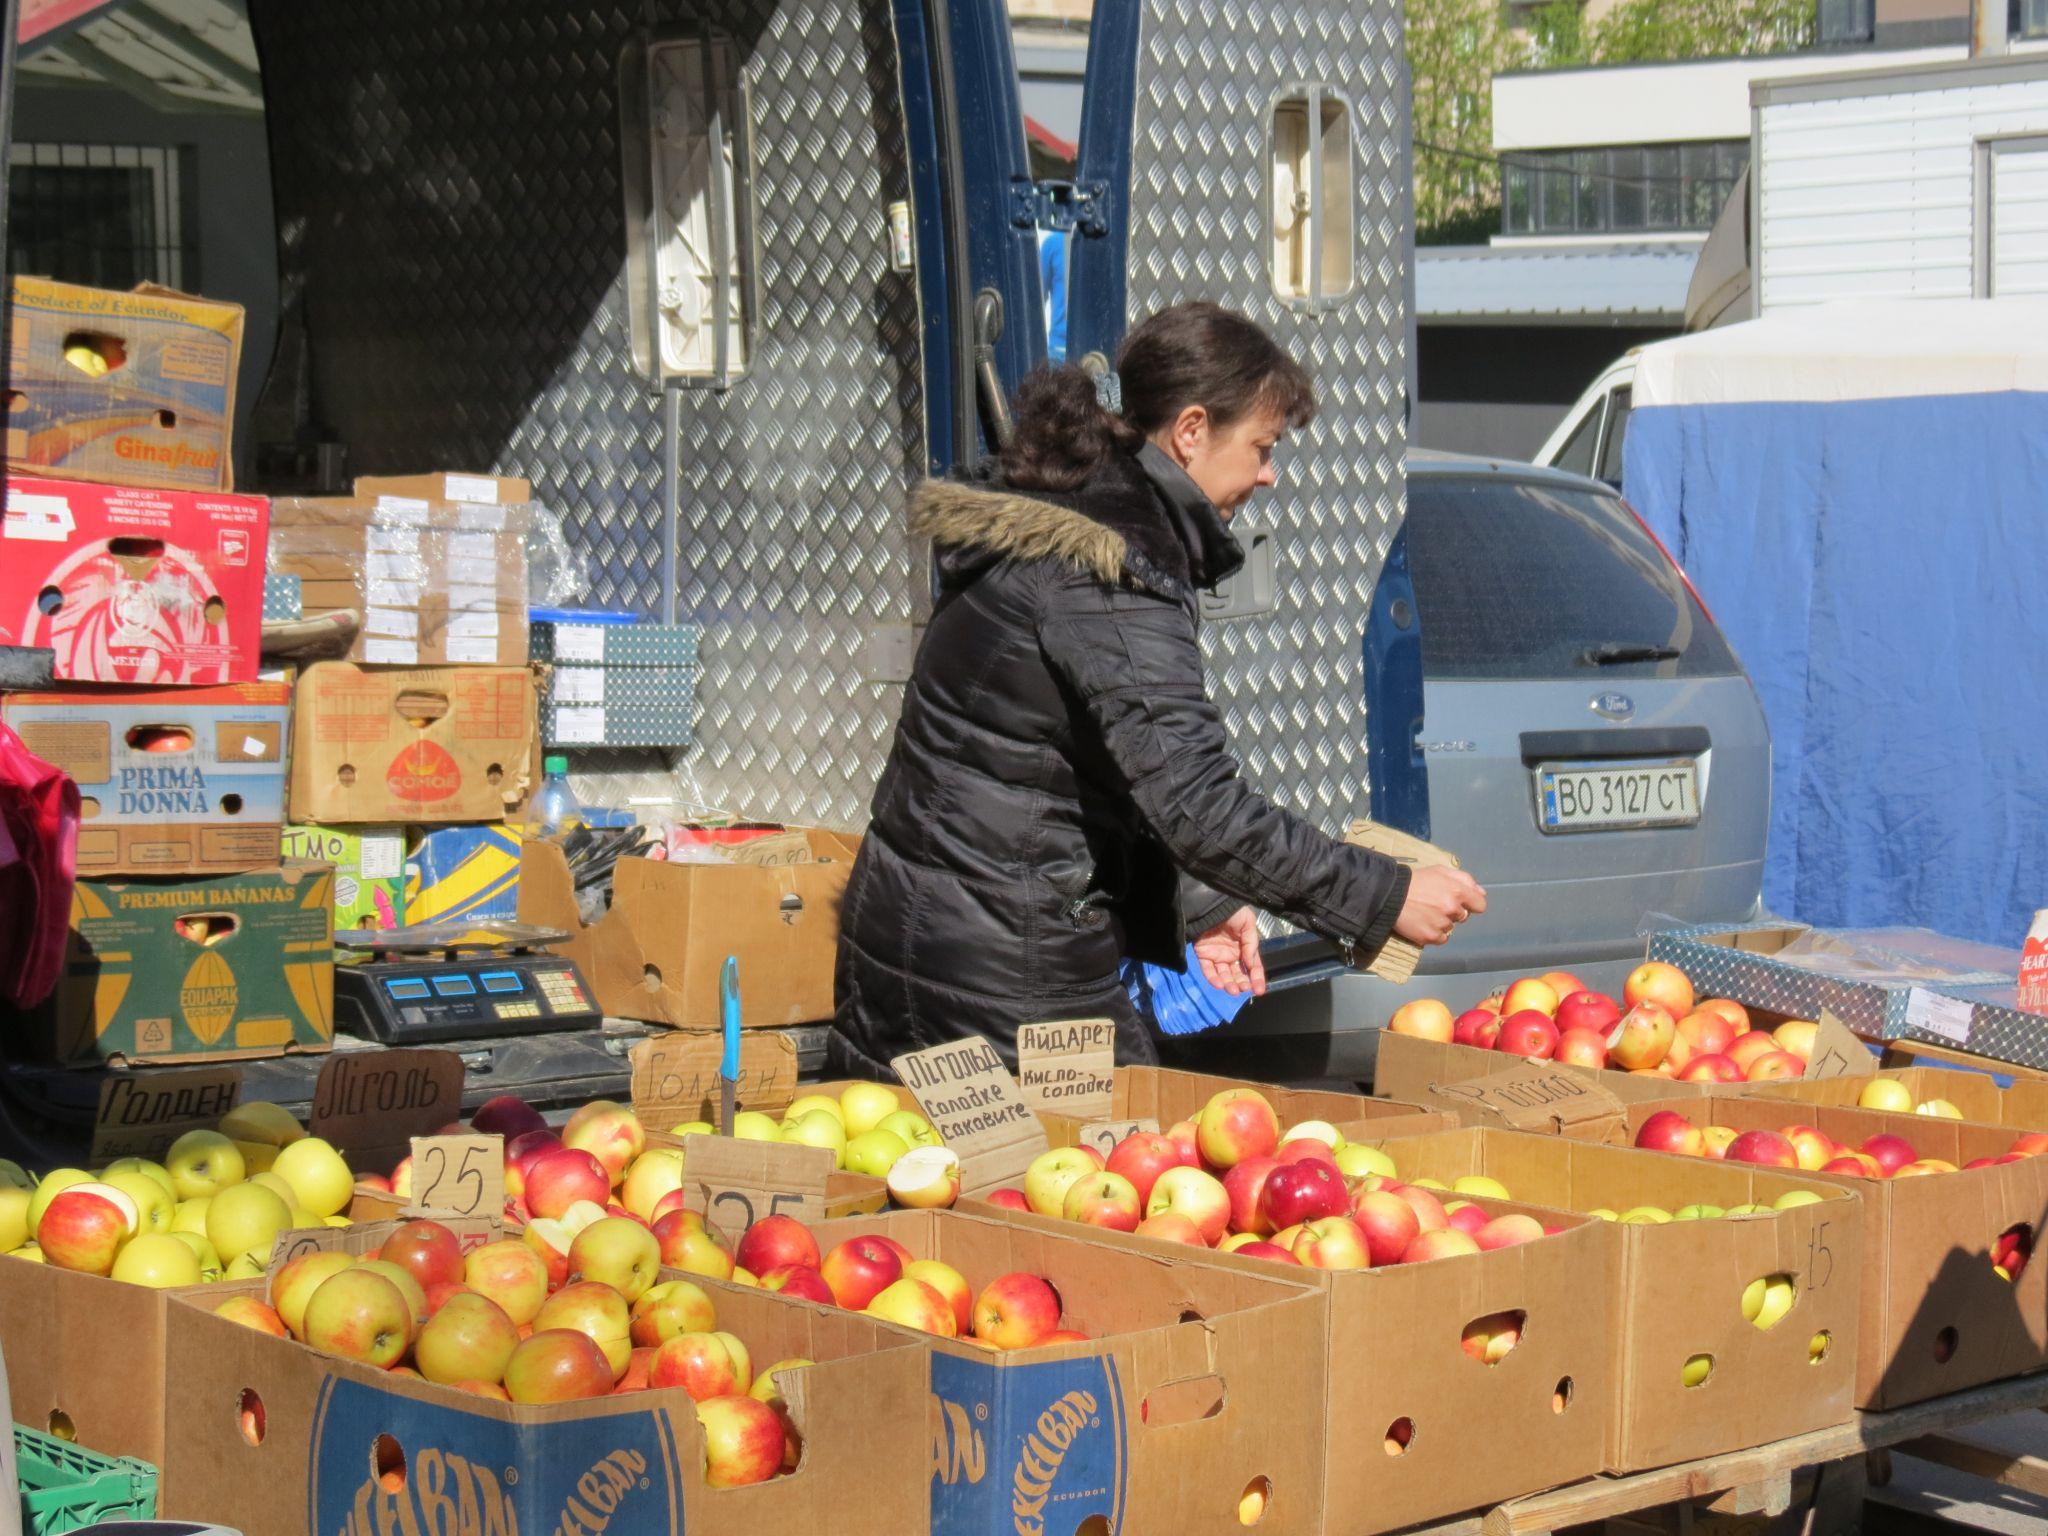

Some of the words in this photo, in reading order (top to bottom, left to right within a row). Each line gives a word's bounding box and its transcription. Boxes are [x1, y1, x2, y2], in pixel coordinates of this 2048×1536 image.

[89, 299, 106, 311] of
[112, 301, 188, 322] Ecuador
[114, 435, 219, 471] Ginafruit
[1605, 695, 1629, 711] Ford
[119, 766, 206, 789] PRIMA
[118, 791, 208, 814] DONNA
[1600, 774, 1651, 814] 3127
[1657, 772, 1688, 811] CT
[119, 890, 206, 909] PREMIUM
[209, 887, 296, 905] BANANAS
[180, 986, 239, 1007] EQUAPAK
[188, 1007, 231, 1018] ECUADOR
[421, 1146, 489, 1215] 25
[1807, 1221, 1832, 1290] 15
[1053, 1487, 1107, 1502] ECUADOR
